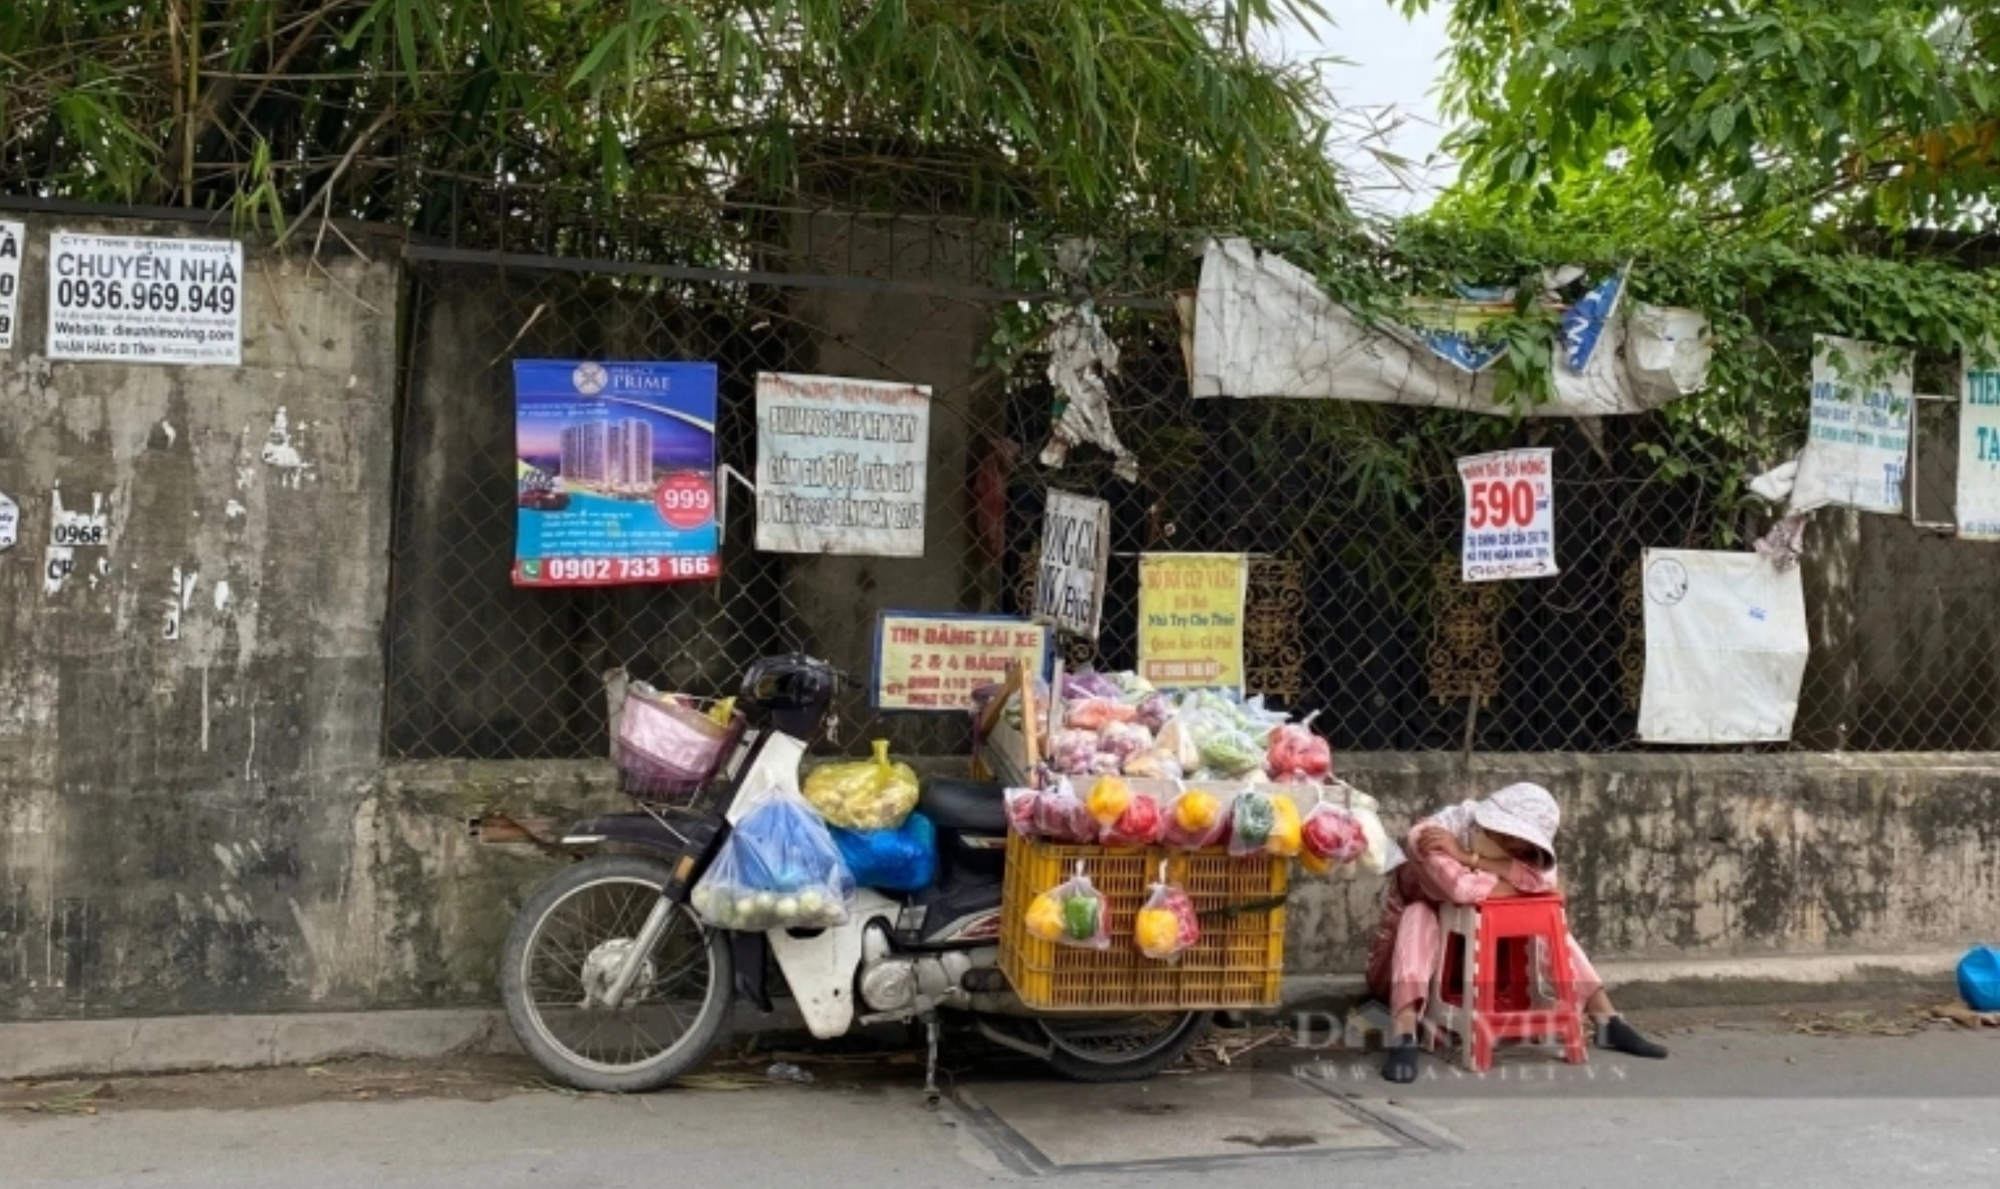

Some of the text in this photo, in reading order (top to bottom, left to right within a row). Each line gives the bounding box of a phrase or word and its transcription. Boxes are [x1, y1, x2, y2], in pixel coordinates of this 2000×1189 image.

[60, 237, 90, 246] CTY
[57, 250, 237, 284] CHUYỂN NHÀ
[57, 278, 236, 314] 0936.969.949
[55, 321, 235, 347] Website: dieunhimoving.com
[613, 376, 671, 391] PRIME
[825, 451, 861, 491] 50%
[664, 488, 711, 509] 999
[1470, 479, 1535, 529] 590
[54, 523, 102, 543] 0968
[550, 556, 711, 580] 0902 733 166
[924, 623, 976, 646] BẰNG
[981, 628, 1009, 647] LÁI
[1014, 632, 1038, 647] XE
[911, 654, 923, 669] 2
[928, 654, 942, 670] &
[947, 656, 959, 670] 4
